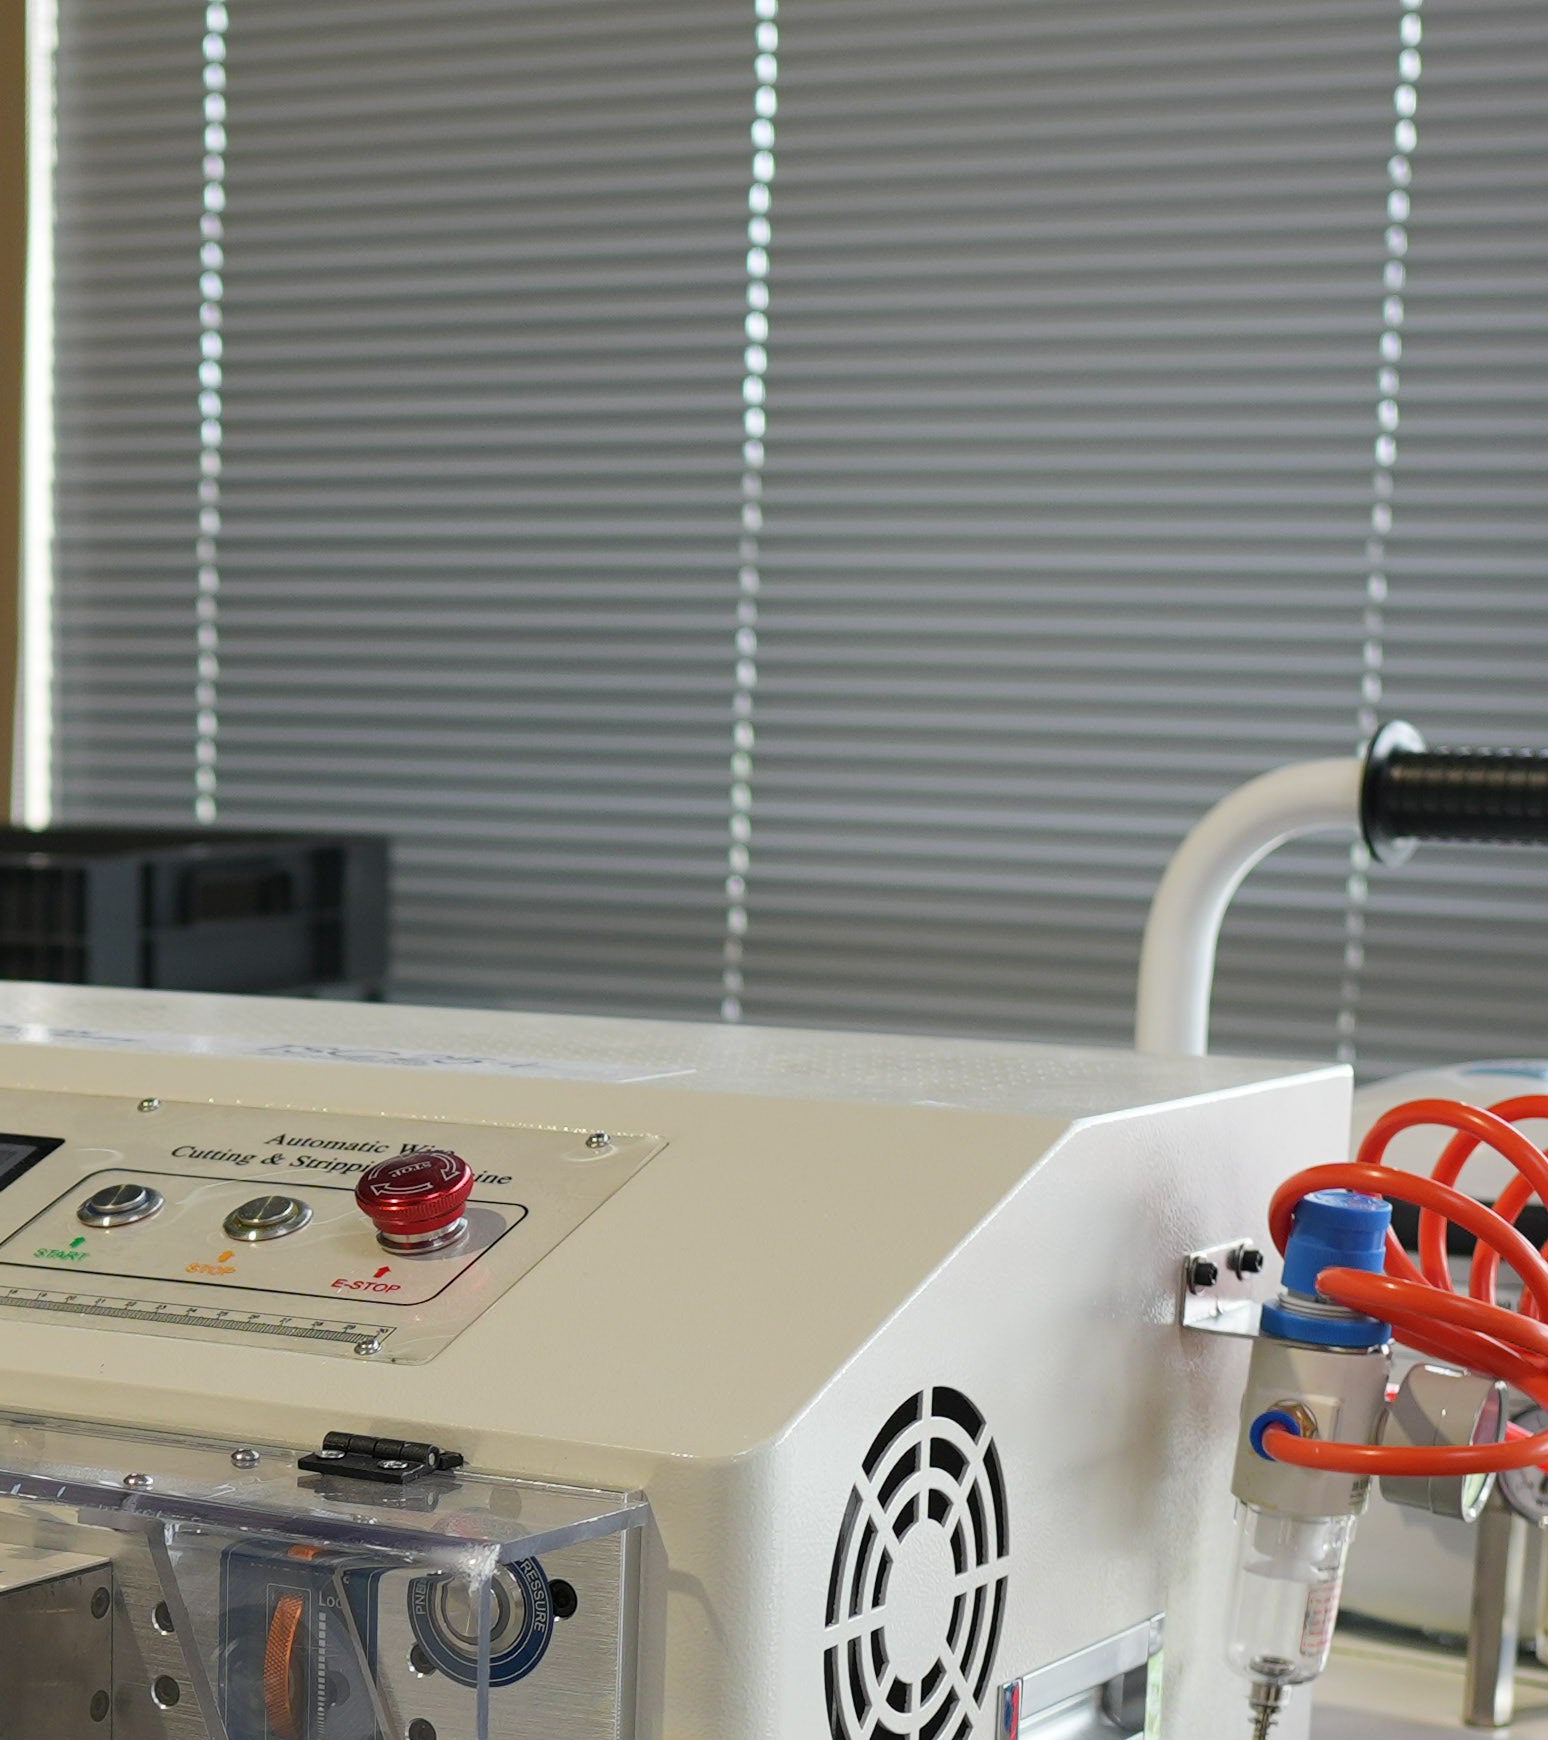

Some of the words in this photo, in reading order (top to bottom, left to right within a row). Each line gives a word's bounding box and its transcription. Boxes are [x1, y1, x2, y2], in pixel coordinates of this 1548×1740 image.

[264, 1133, 390, 1154] Automatic
[171, 1145, 257, 1167] Cutting
[260, 1152, 285, 1166] &
[290, 1155, 374, 1174] Strippi
[388, 1161, 432, 1177] STOP
[33, 1248, 89, 1261] START
[186, 1262, 236, 1275] STOP
[330, 1278, 403, 1294] E-STOP
[319, 1591, 342, 1608] Loo
[520, 1557, 546, 1632] RESSURE
